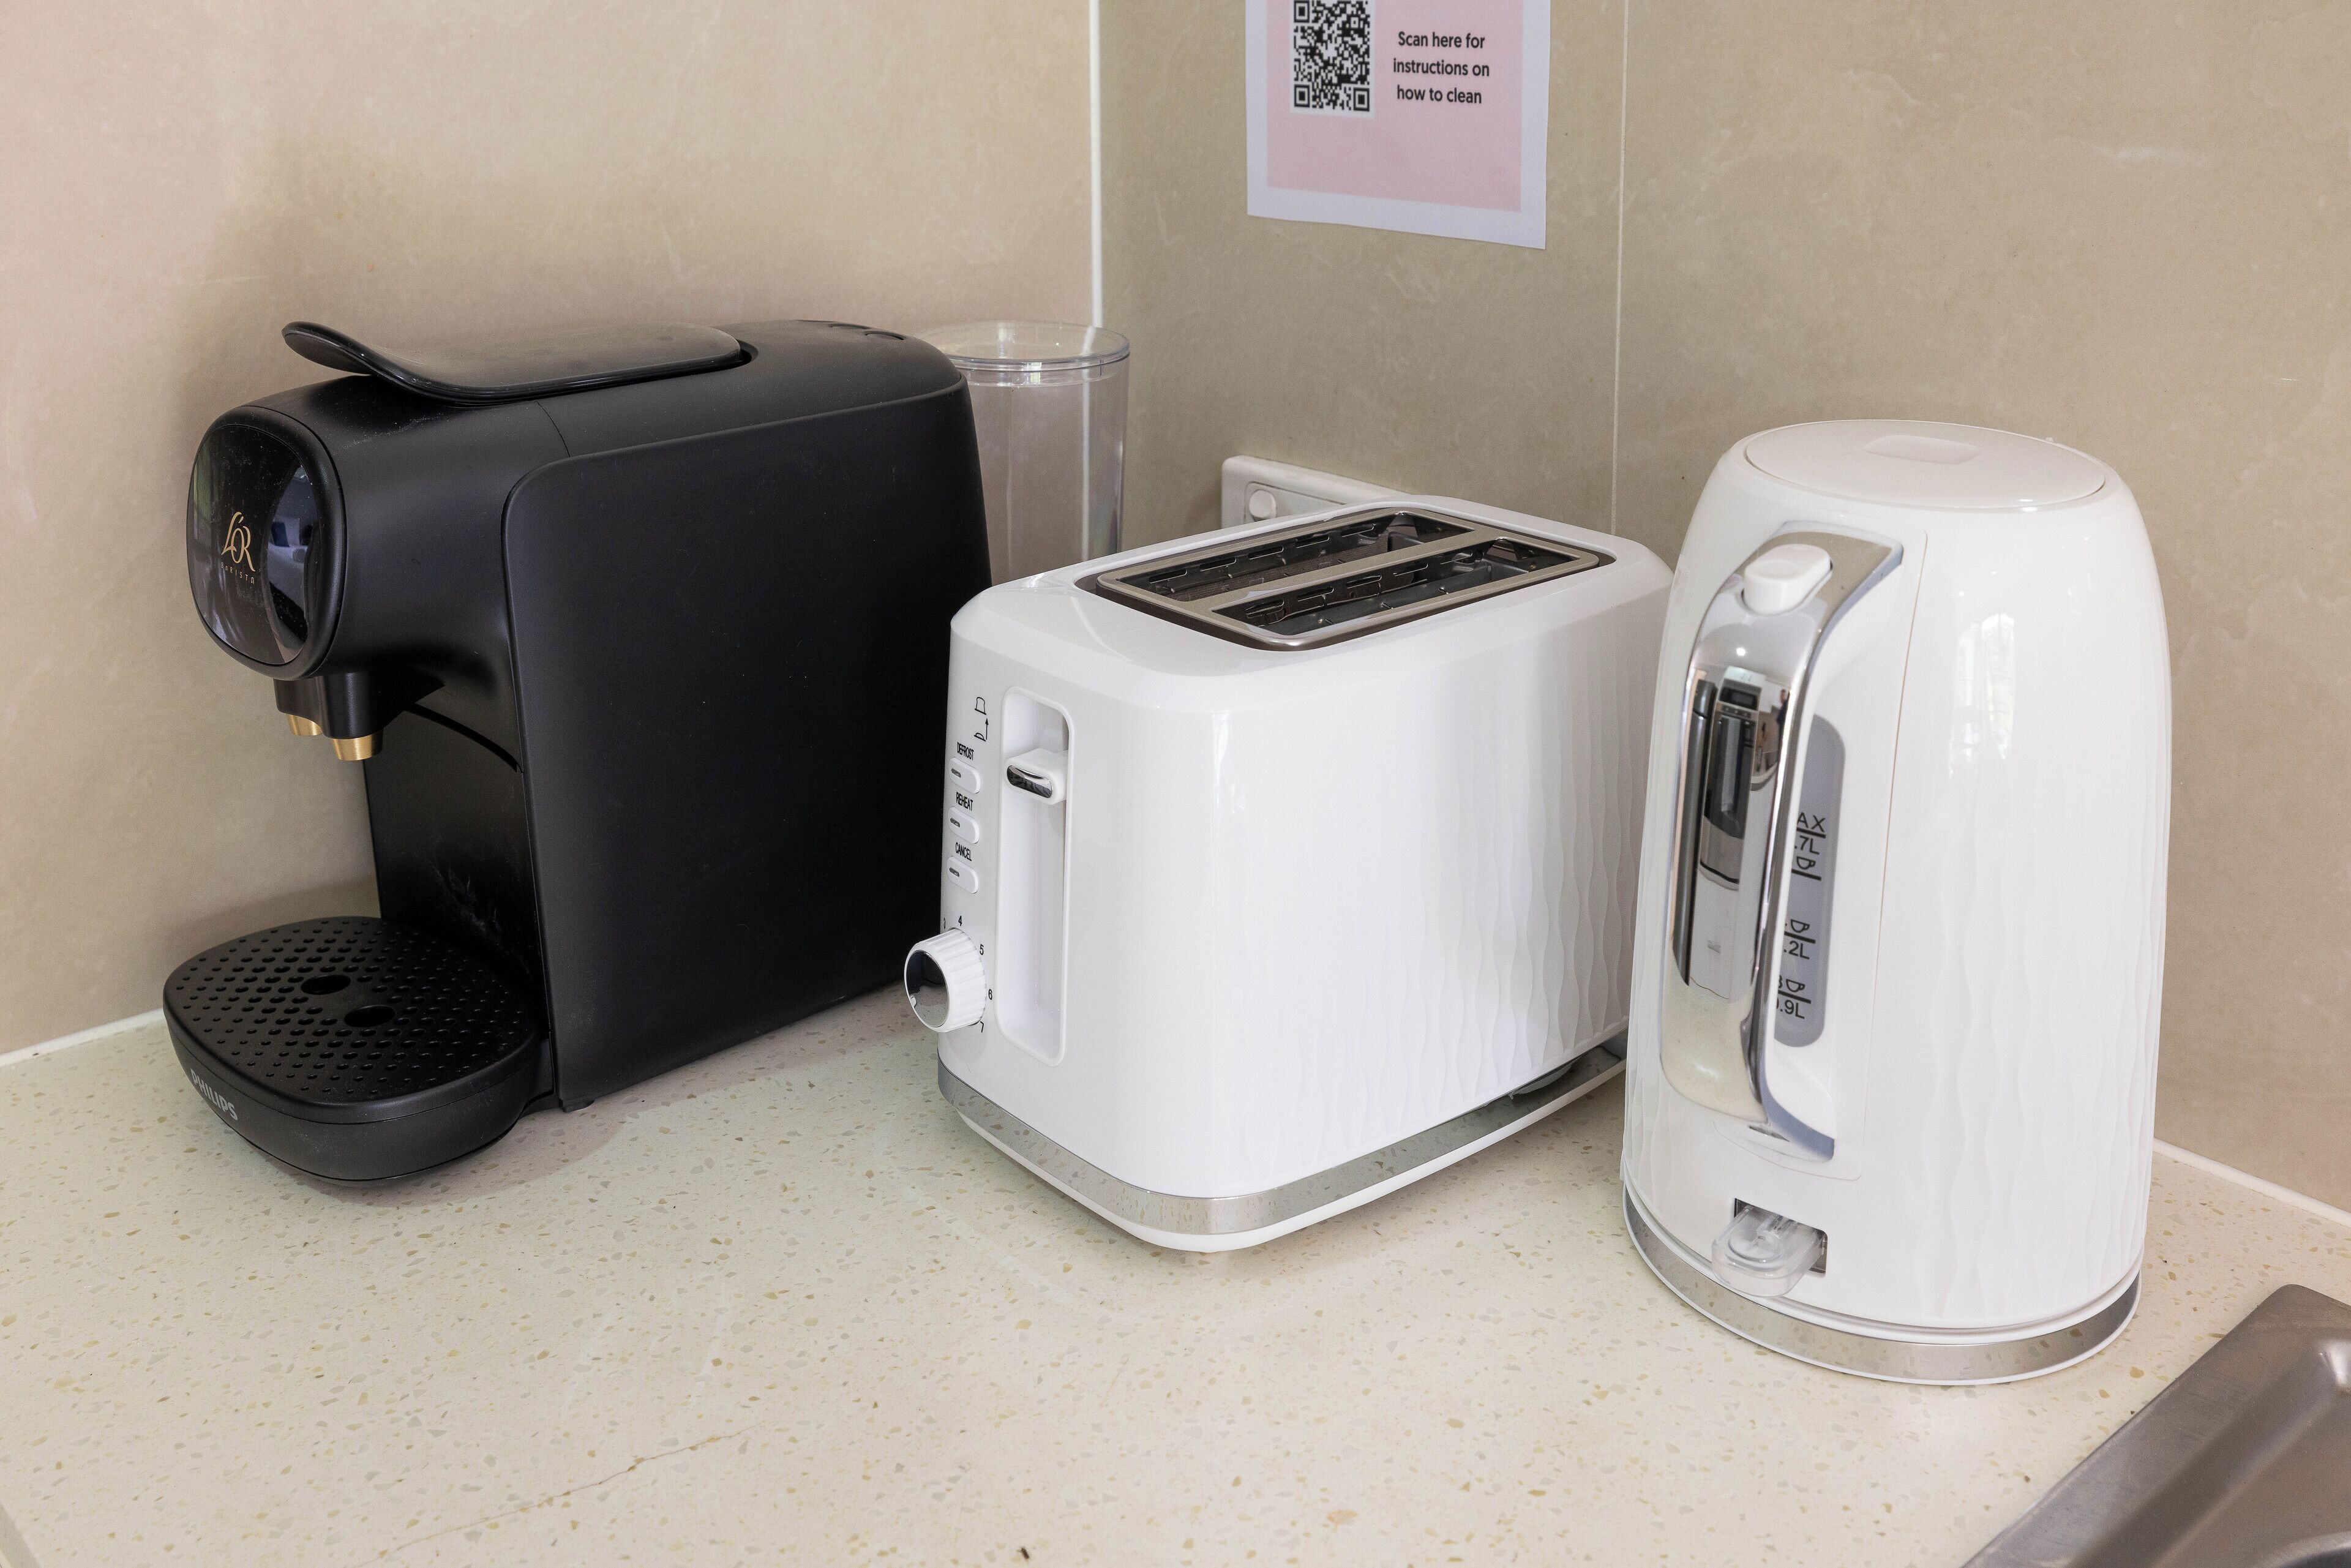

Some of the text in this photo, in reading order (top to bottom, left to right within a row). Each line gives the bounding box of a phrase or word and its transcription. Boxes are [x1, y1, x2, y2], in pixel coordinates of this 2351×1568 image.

[1398, 31, 1485, 49] Scan here for
[1393, 58, 1490, 77] instructions on
[1397, 84, 1482, 104] how to clean
[956, 741, 974, 760] DEFROST
[956, 792, 973, 811] REHEAT
[1796, 812, 1826, 833] AX
[955, 842, 972, 861] CANCEL
[1794, 835, 1820, 855] .7L
[958, 915, 962, 927] 4
[979, 943, 984, 955] 5
[1783, 940, 1810, 960] .2L
[988, 989, 993, 1000] 6
[1776, 997, 1805, 1019] .9L
[190, 1068, 238, 1121] PHILIPS
